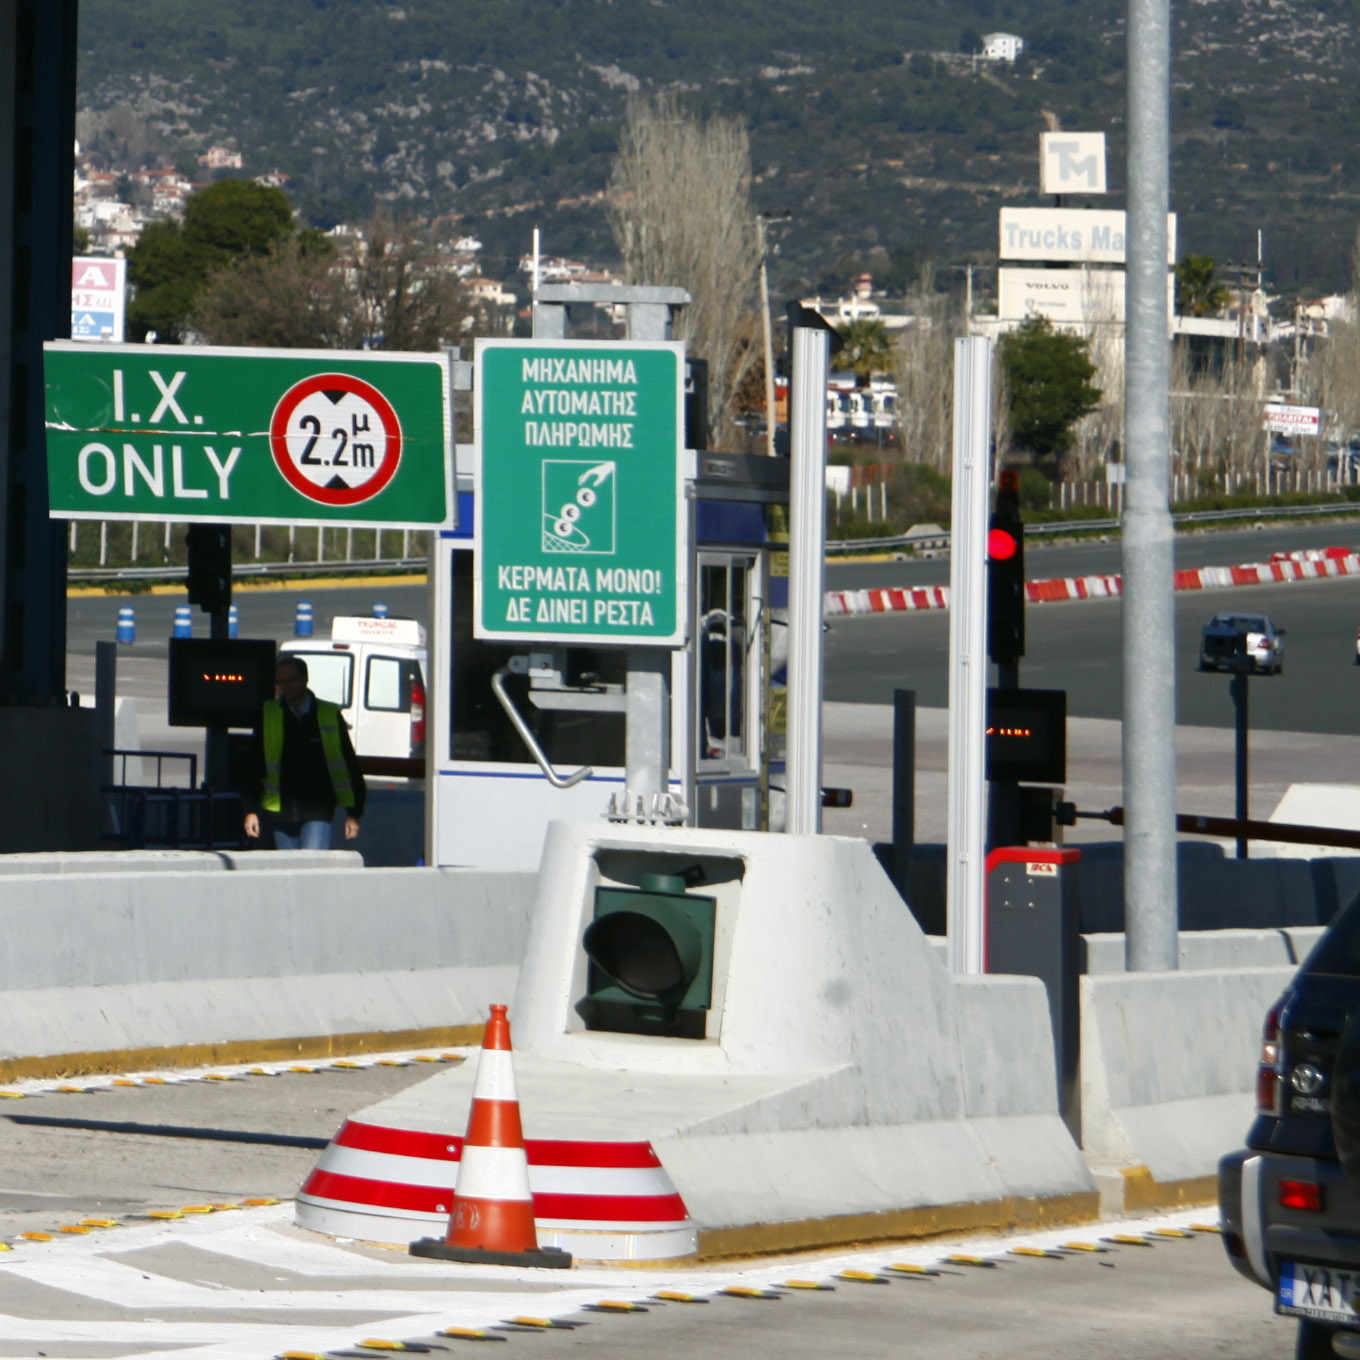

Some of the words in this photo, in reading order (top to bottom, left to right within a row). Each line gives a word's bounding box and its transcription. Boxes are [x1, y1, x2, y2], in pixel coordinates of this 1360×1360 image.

[1005, 223, 1082, 250] Trucks
[522, 358, 637, 384] ΜΗΧΑΝΗΜΑ
[520, 390, 637, 416] ΑΥΤΟΜΑΤΗΣ
[524, 422, 634, 448] ΠΛΗΡΩΜΗΣ
[78, 443, 241, 499] ONLY
[498, 565, 590, 591] ΚΕΡΜΑΤΑ
[596, 568, 662, 594] ΜΟΝΟ!
[506, 597, 531, 622] ΔΕ
[536, 598, 587, 623] ΔΙΝΕΙ
[593, 600, 654, 626] ΡΕΣΤΑ
